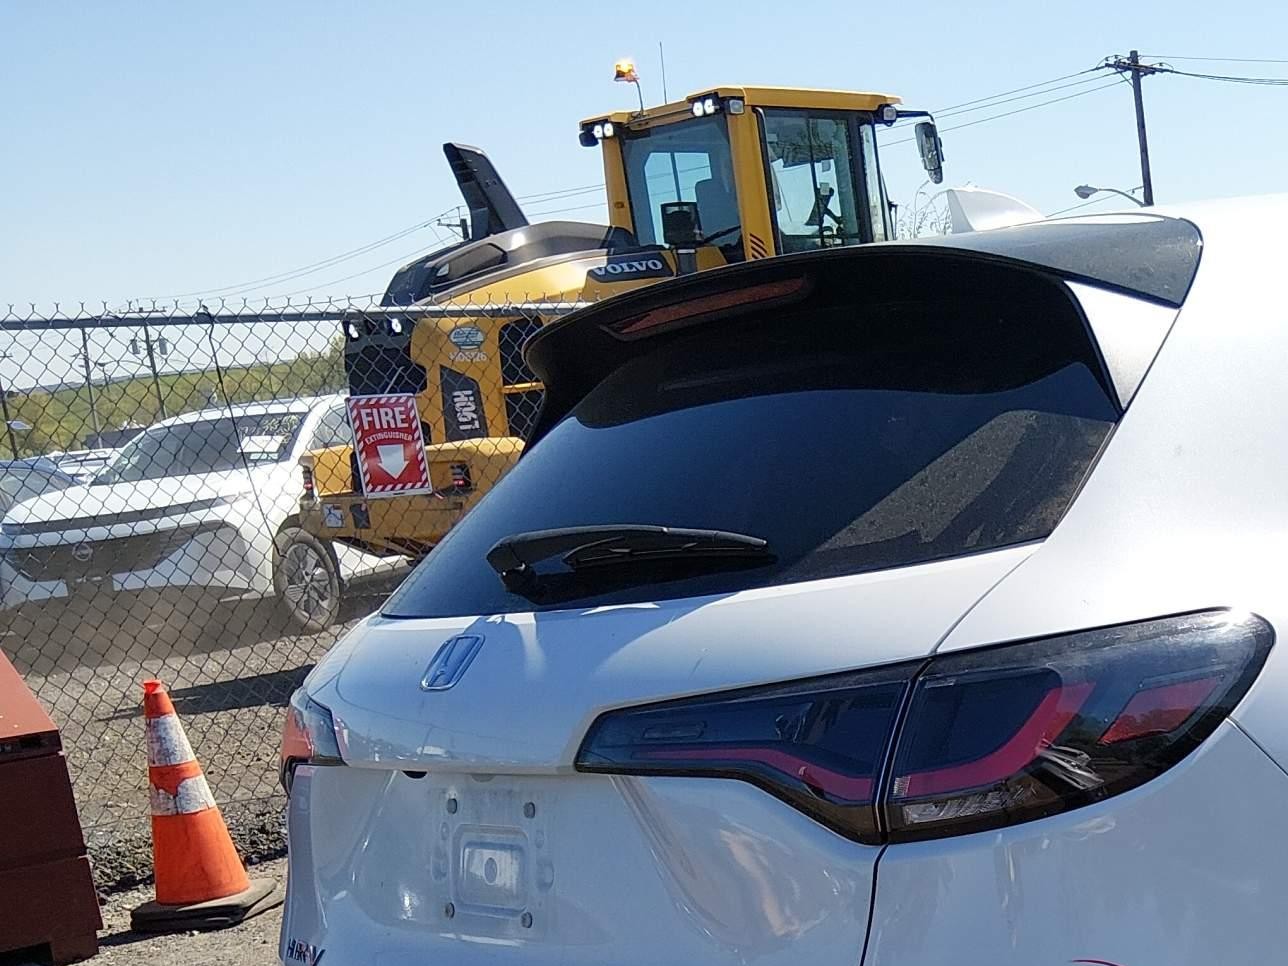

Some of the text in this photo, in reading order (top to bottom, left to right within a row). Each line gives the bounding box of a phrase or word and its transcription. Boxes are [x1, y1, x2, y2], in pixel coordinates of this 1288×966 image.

[592, 259, 663, 276] VOLVO
[360, 406, 409, 430] FIRE
[364, 430, 413, 445] EXTINGUISHER
